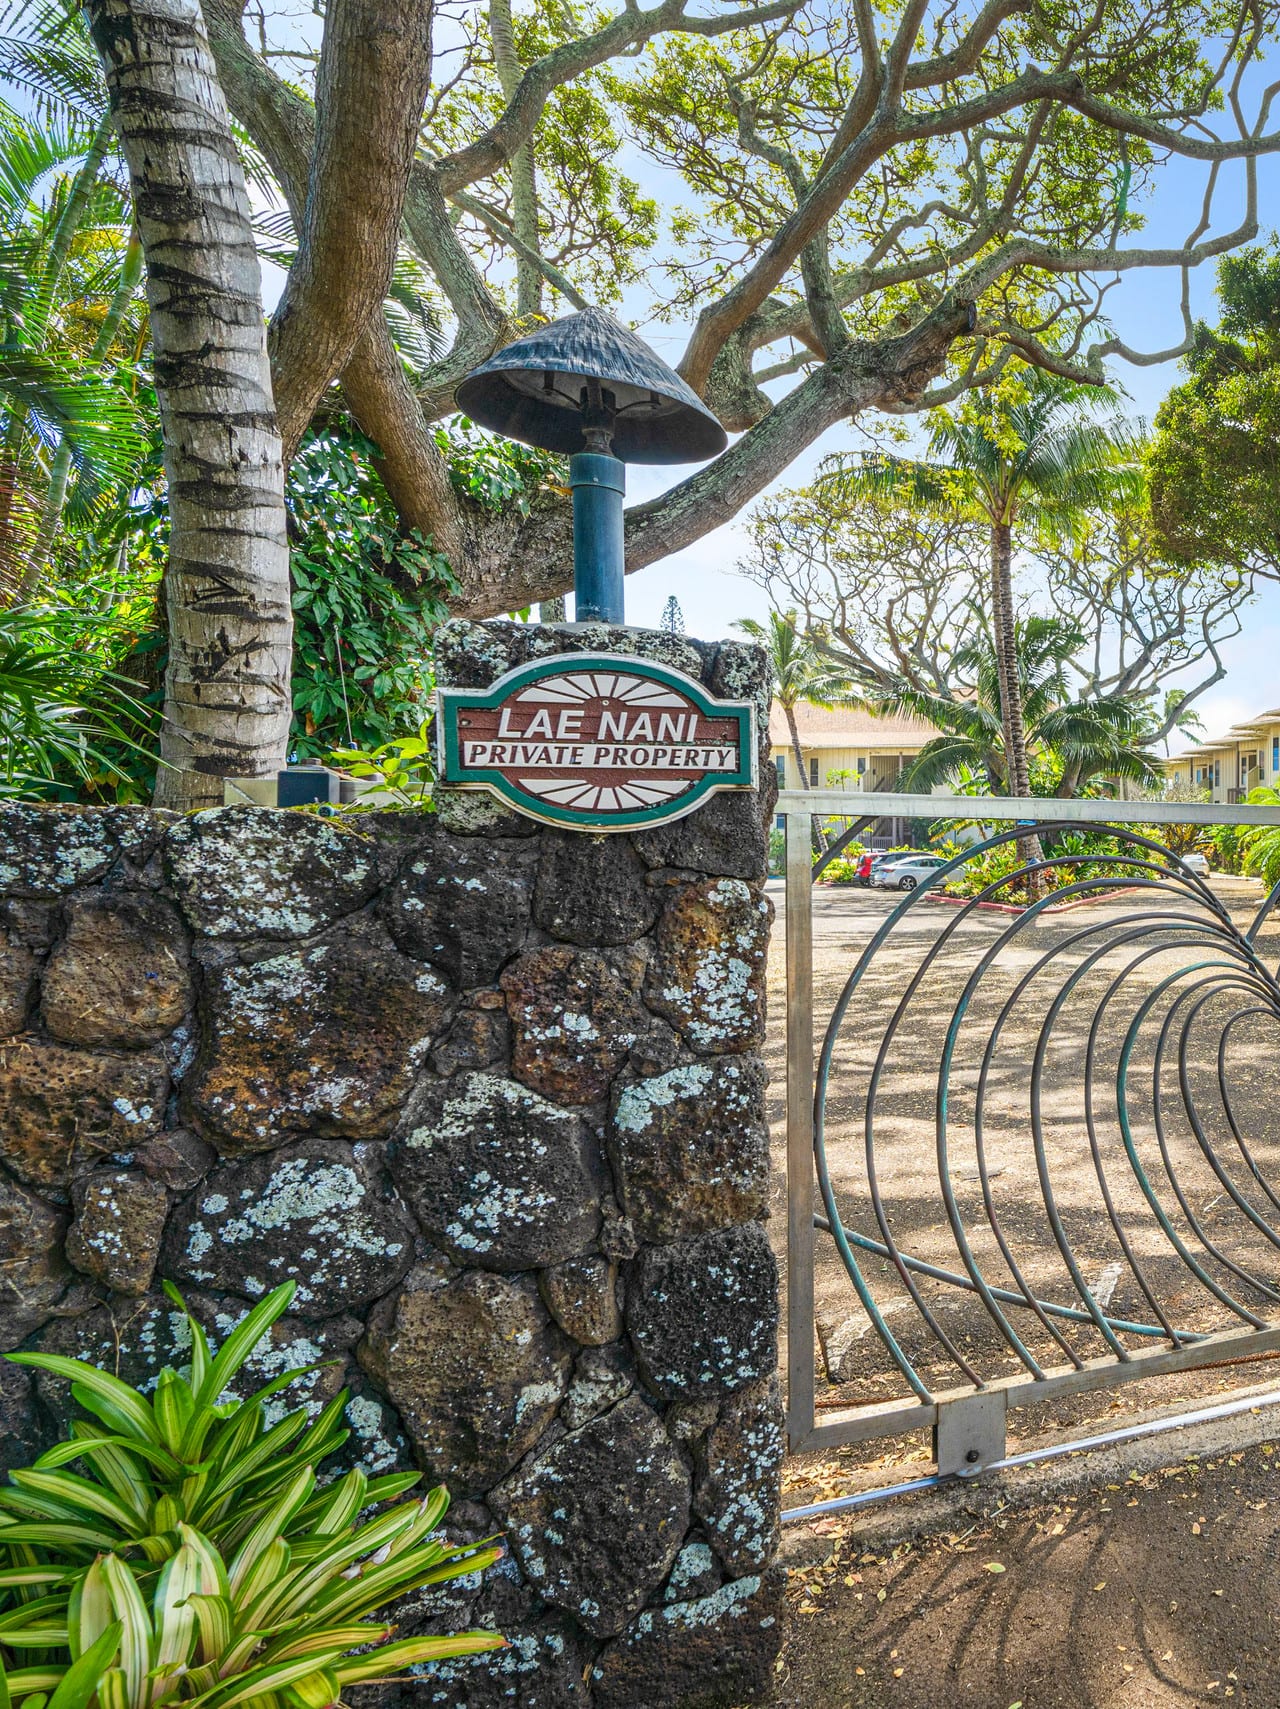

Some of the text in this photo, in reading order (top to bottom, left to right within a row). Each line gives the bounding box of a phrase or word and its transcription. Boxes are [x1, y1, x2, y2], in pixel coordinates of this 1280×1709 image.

[498, 708, 698, 742] LAE NANI
[469, 744, 733, 767] PRIVATE PROPERTY
